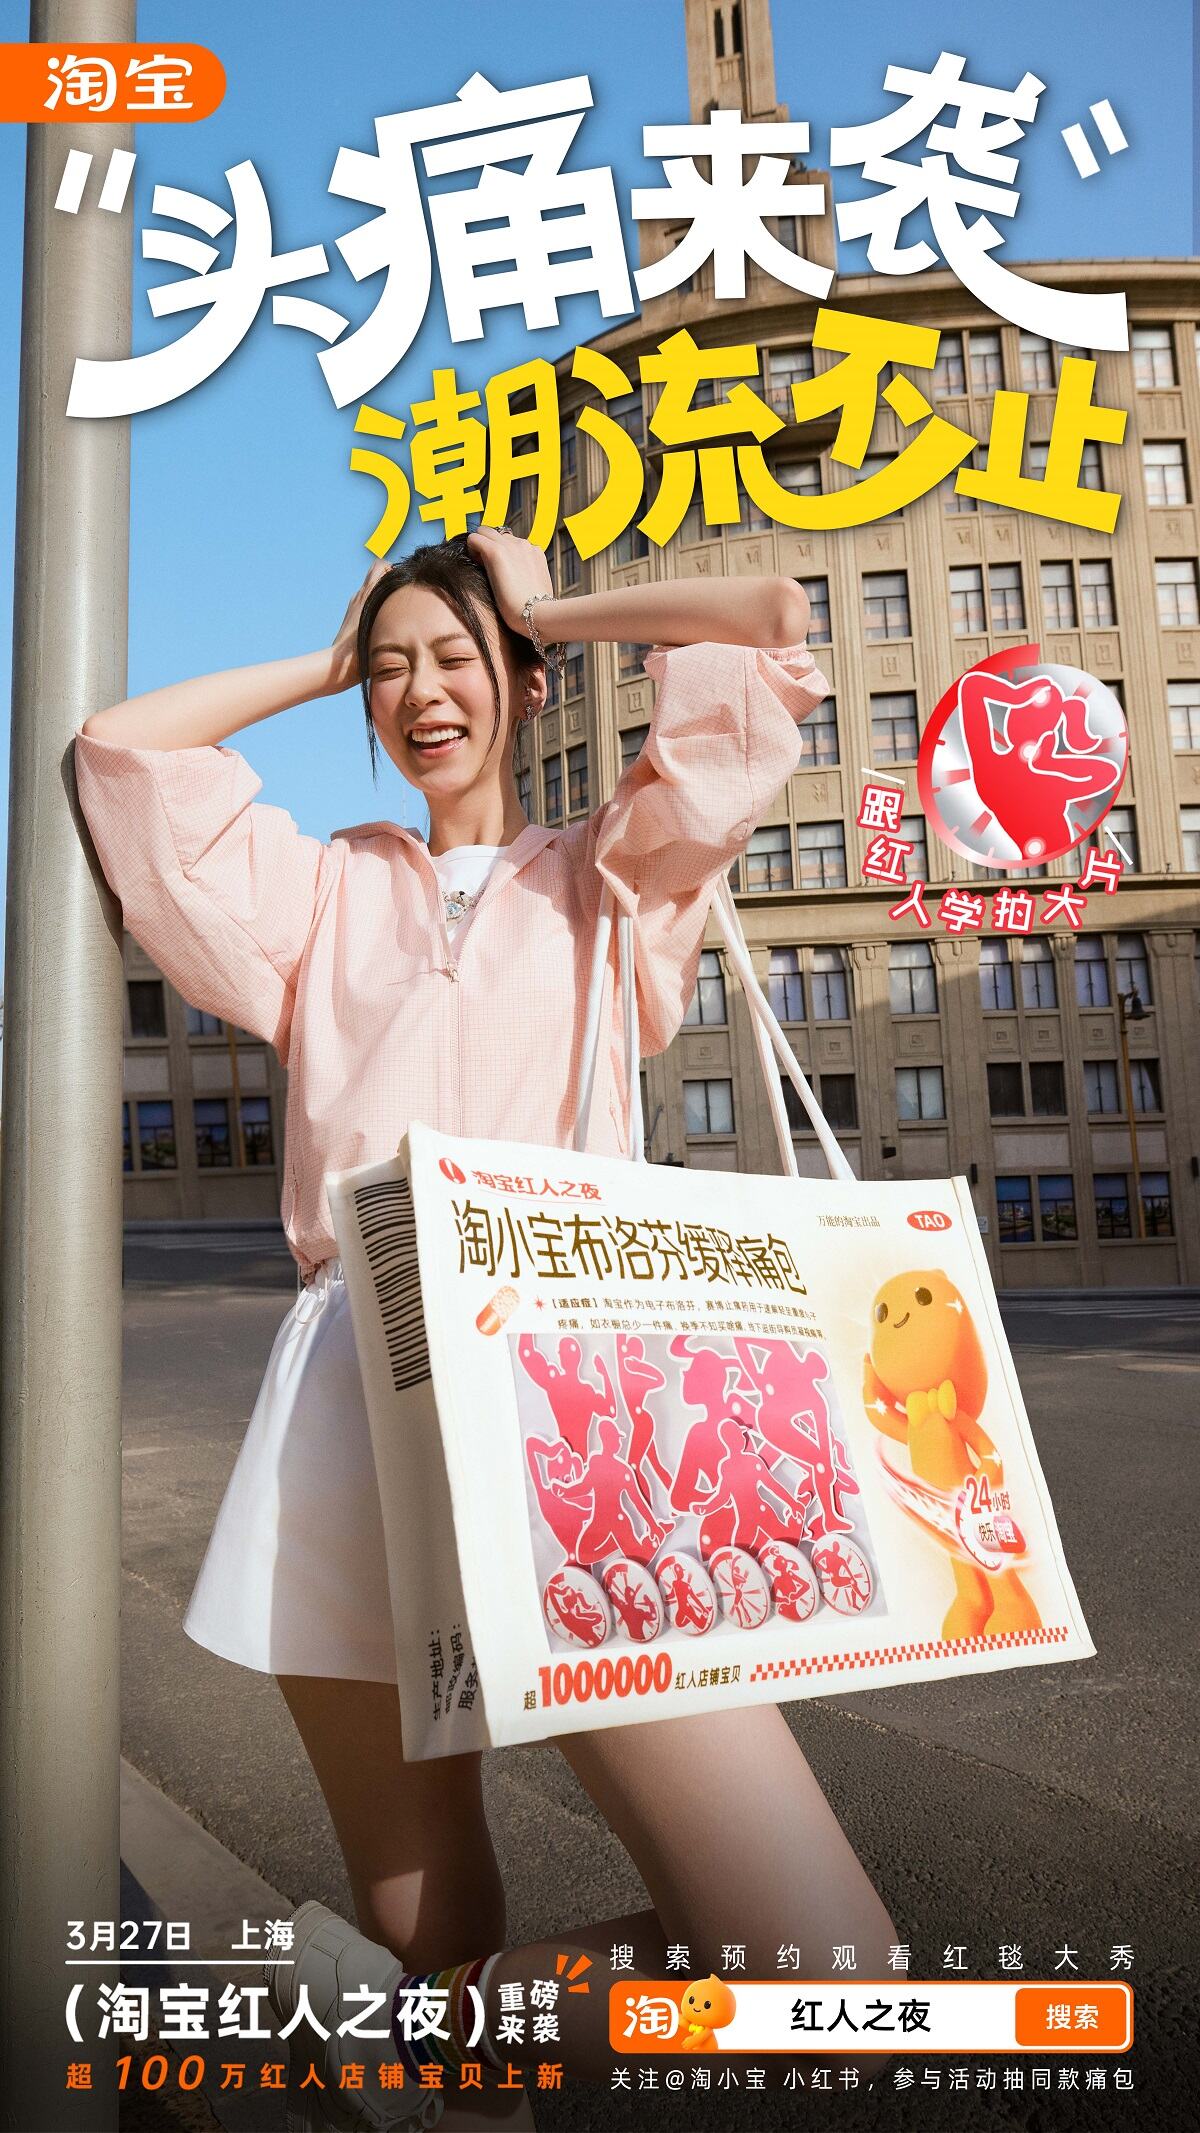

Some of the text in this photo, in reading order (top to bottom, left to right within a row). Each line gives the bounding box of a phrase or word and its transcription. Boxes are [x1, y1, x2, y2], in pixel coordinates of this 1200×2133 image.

[471, 1170, 602, 1200] 淘宝红人之夜
[915, 1213, 945, 1229] TAO
[450, 1199, 808, 1297] 淘小宝布洛芬缓释痛包
[965, 1476, 1011, 1515] 24小时
